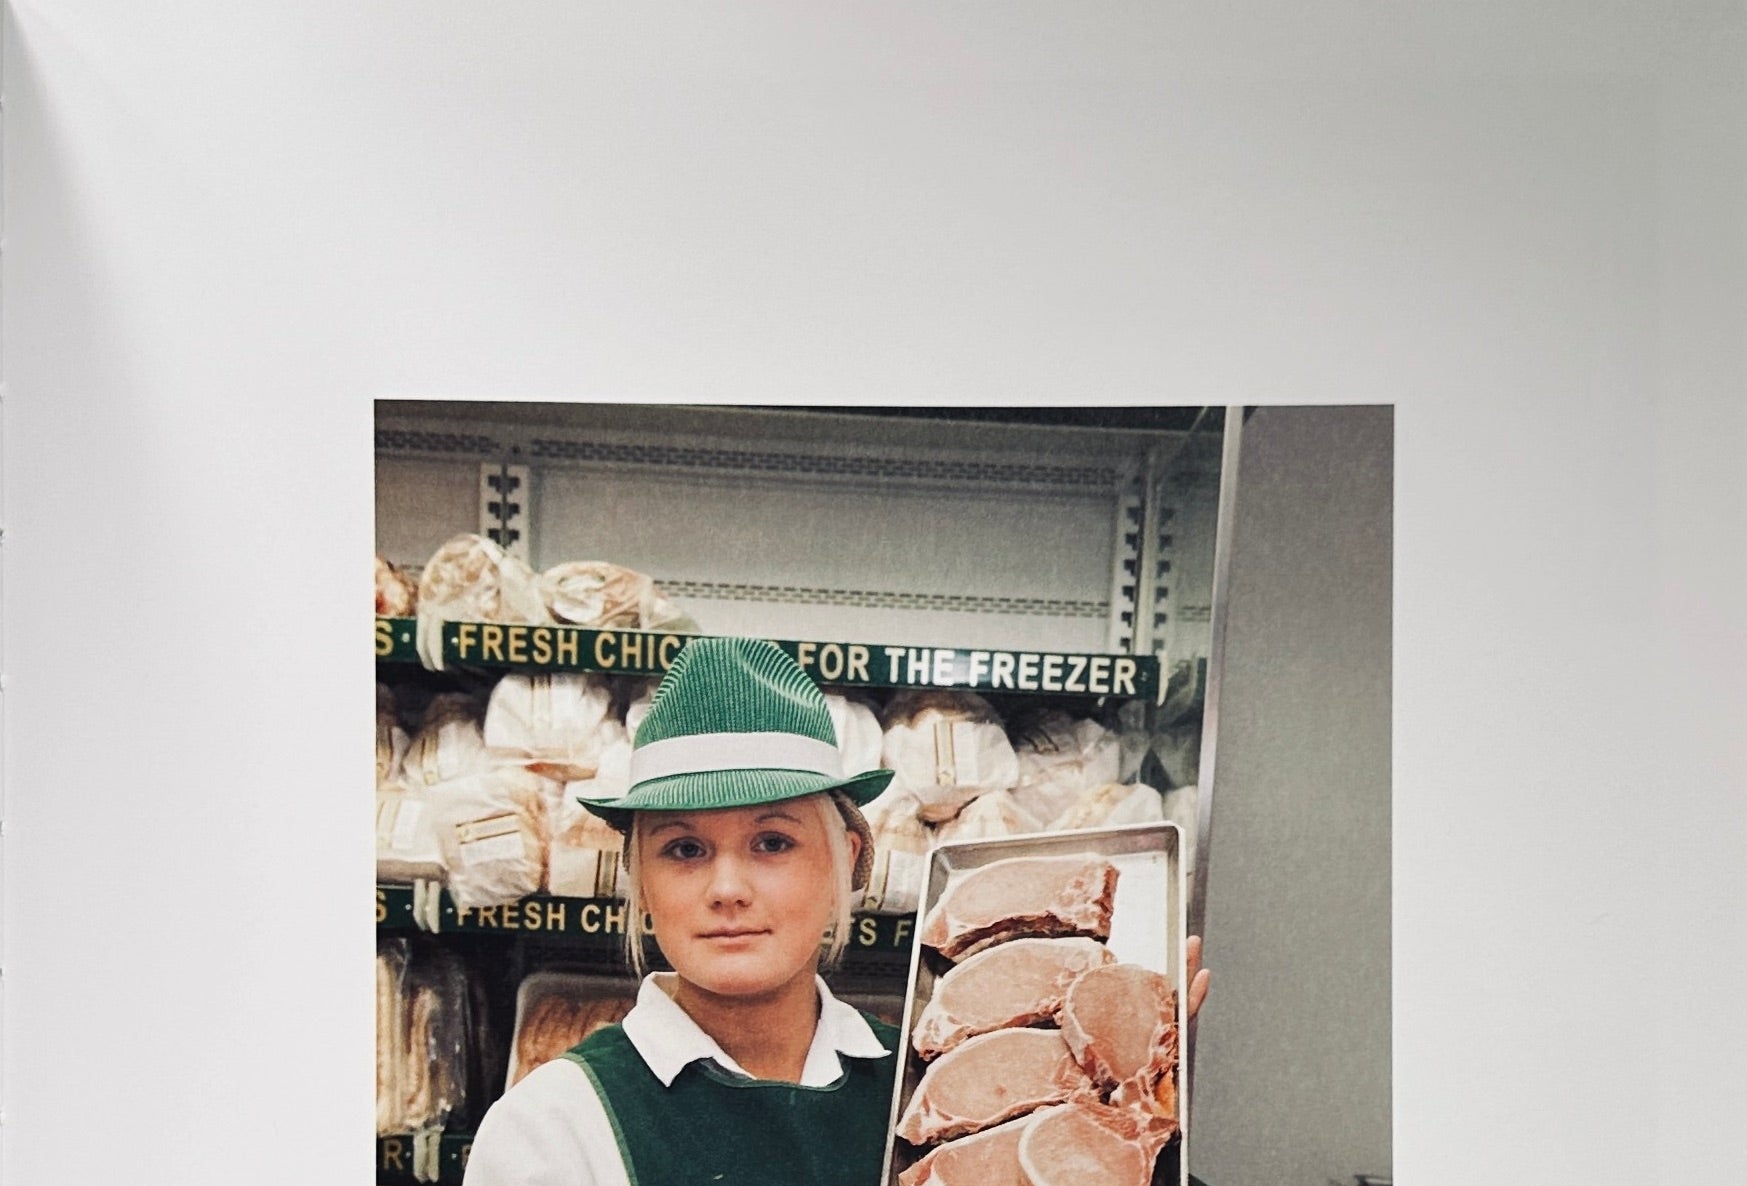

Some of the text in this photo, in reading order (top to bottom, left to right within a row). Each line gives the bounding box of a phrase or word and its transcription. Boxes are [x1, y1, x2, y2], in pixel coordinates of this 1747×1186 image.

[459, 624, 579, 666] FRESH
[798, 643, 869, 683] FOR
[885, 647, 956, 687] THE
[968, 651, 1137, 696] FREEZER
